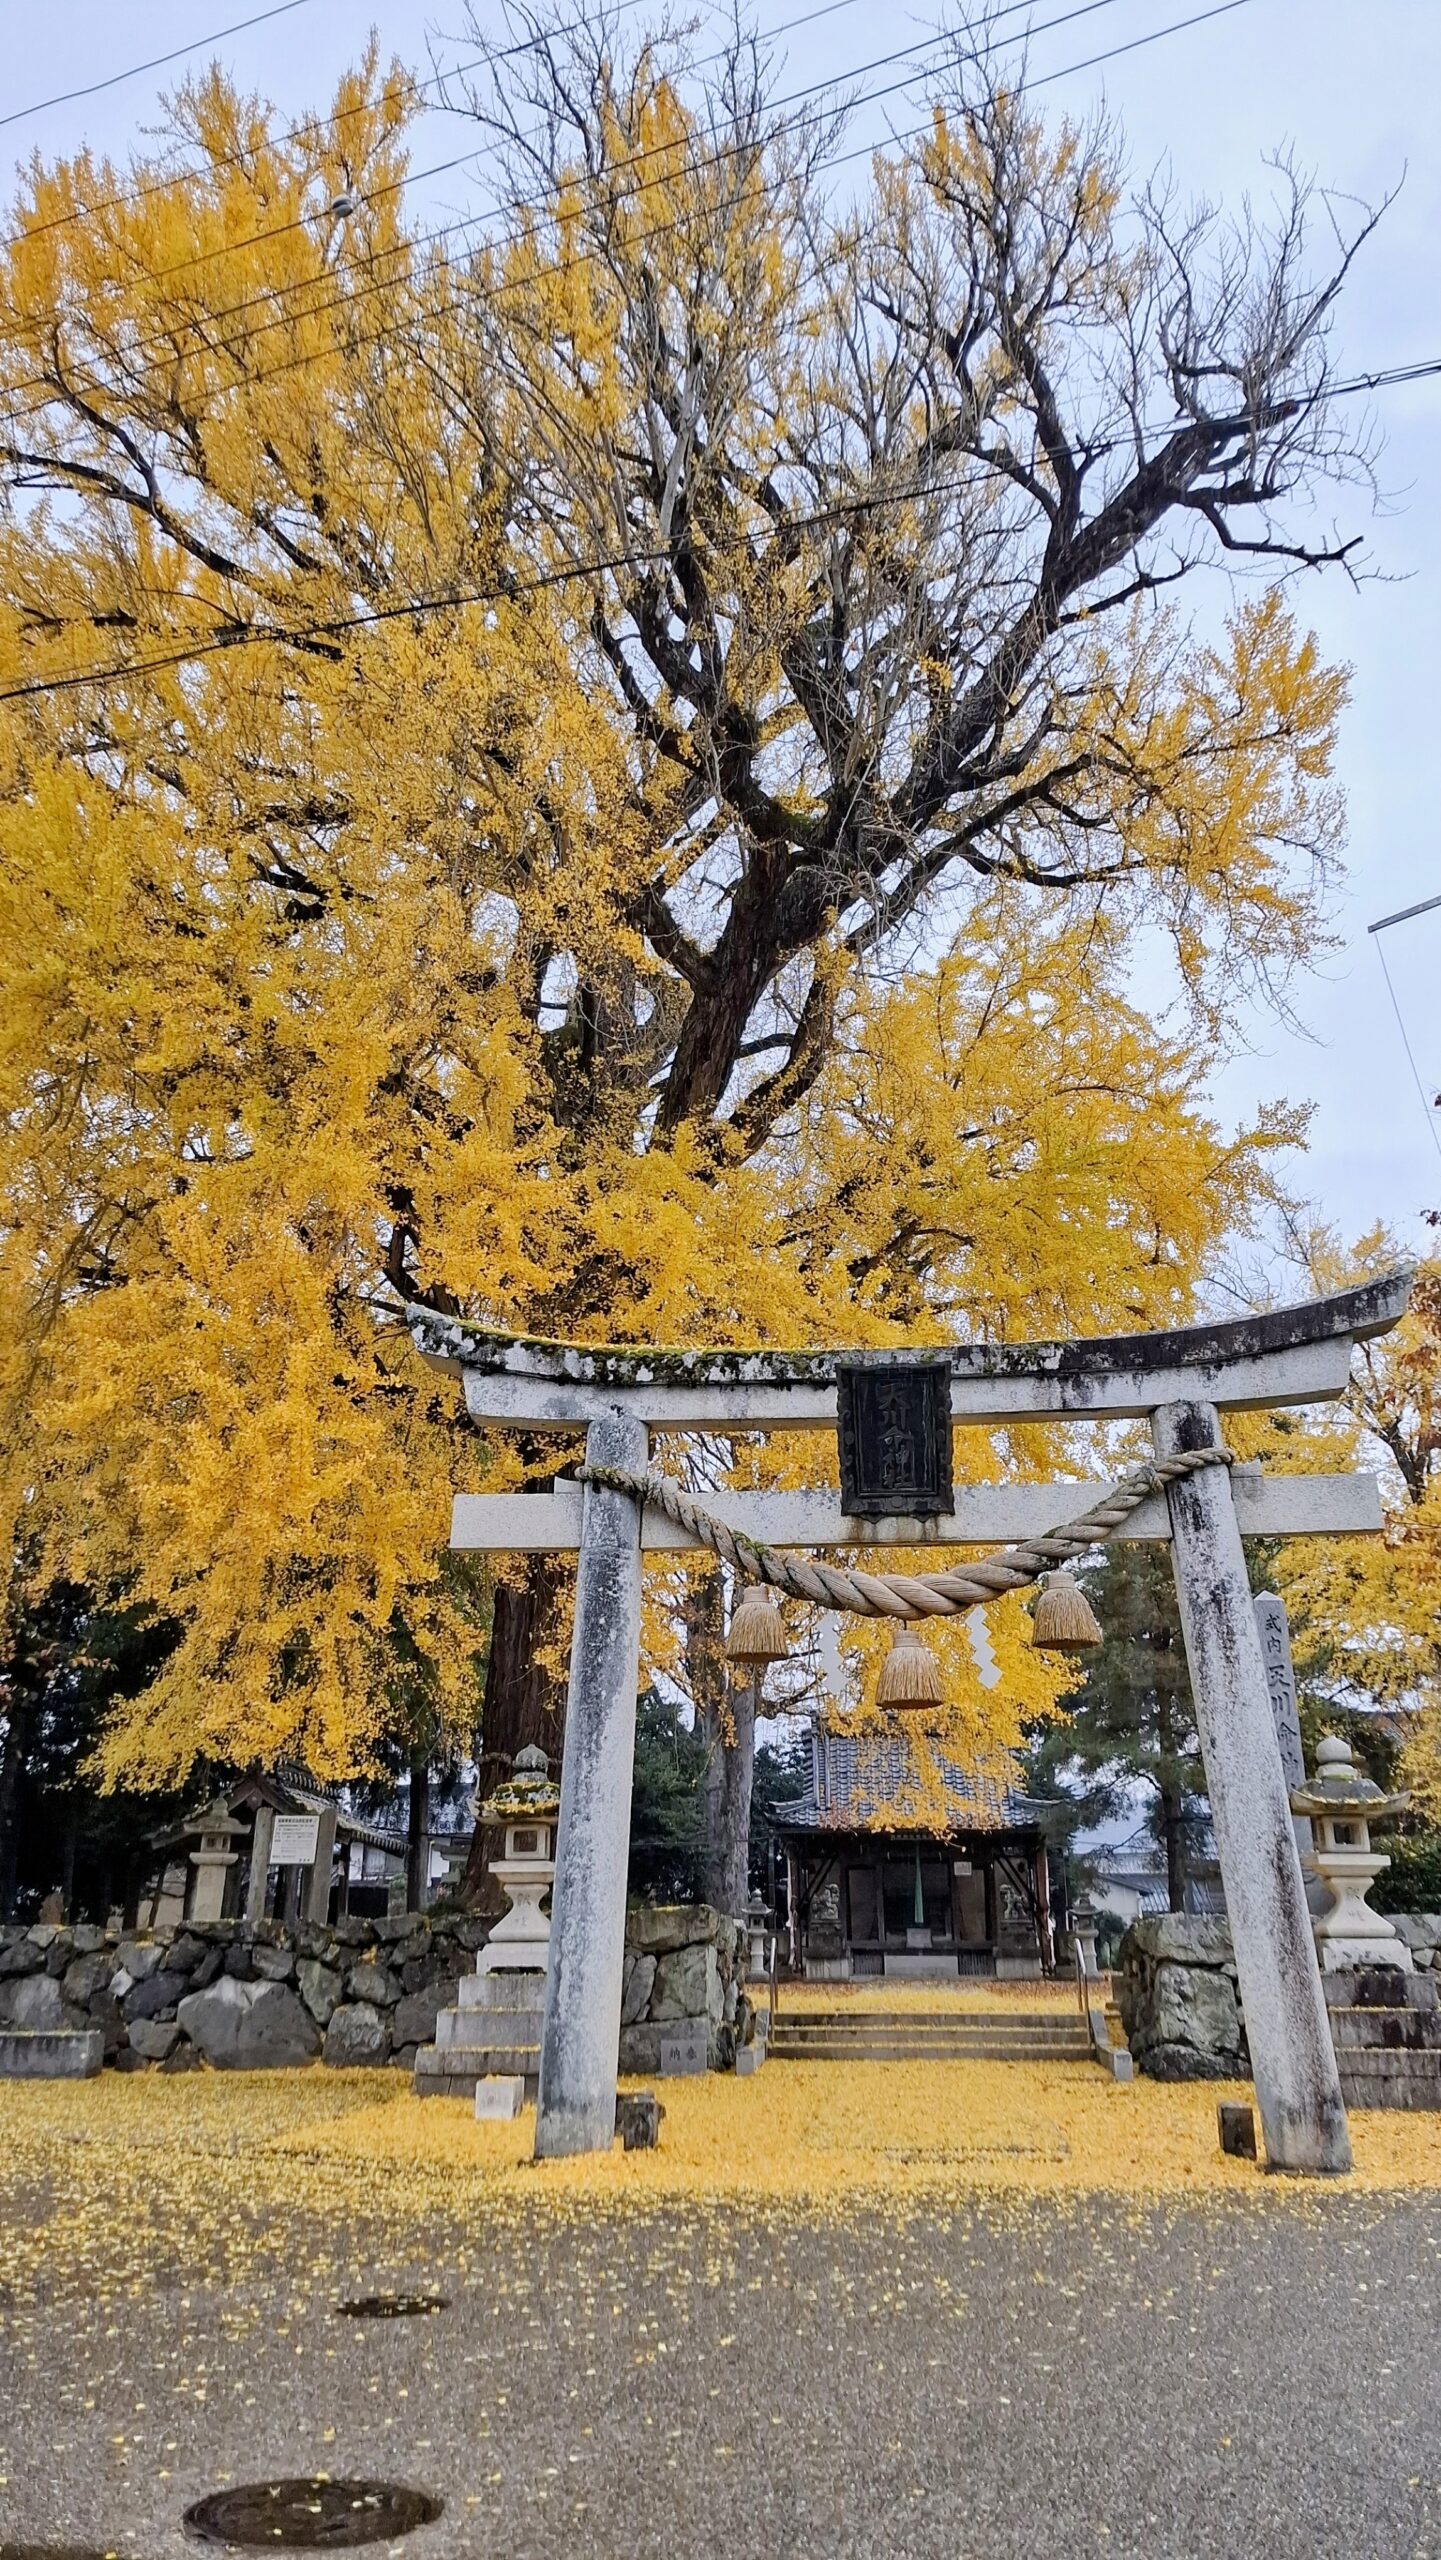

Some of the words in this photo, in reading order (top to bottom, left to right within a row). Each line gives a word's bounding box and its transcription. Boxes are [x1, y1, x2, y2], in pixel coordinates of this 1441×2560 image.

[1264, 1613, 1298, 1789] 式内天川命神
